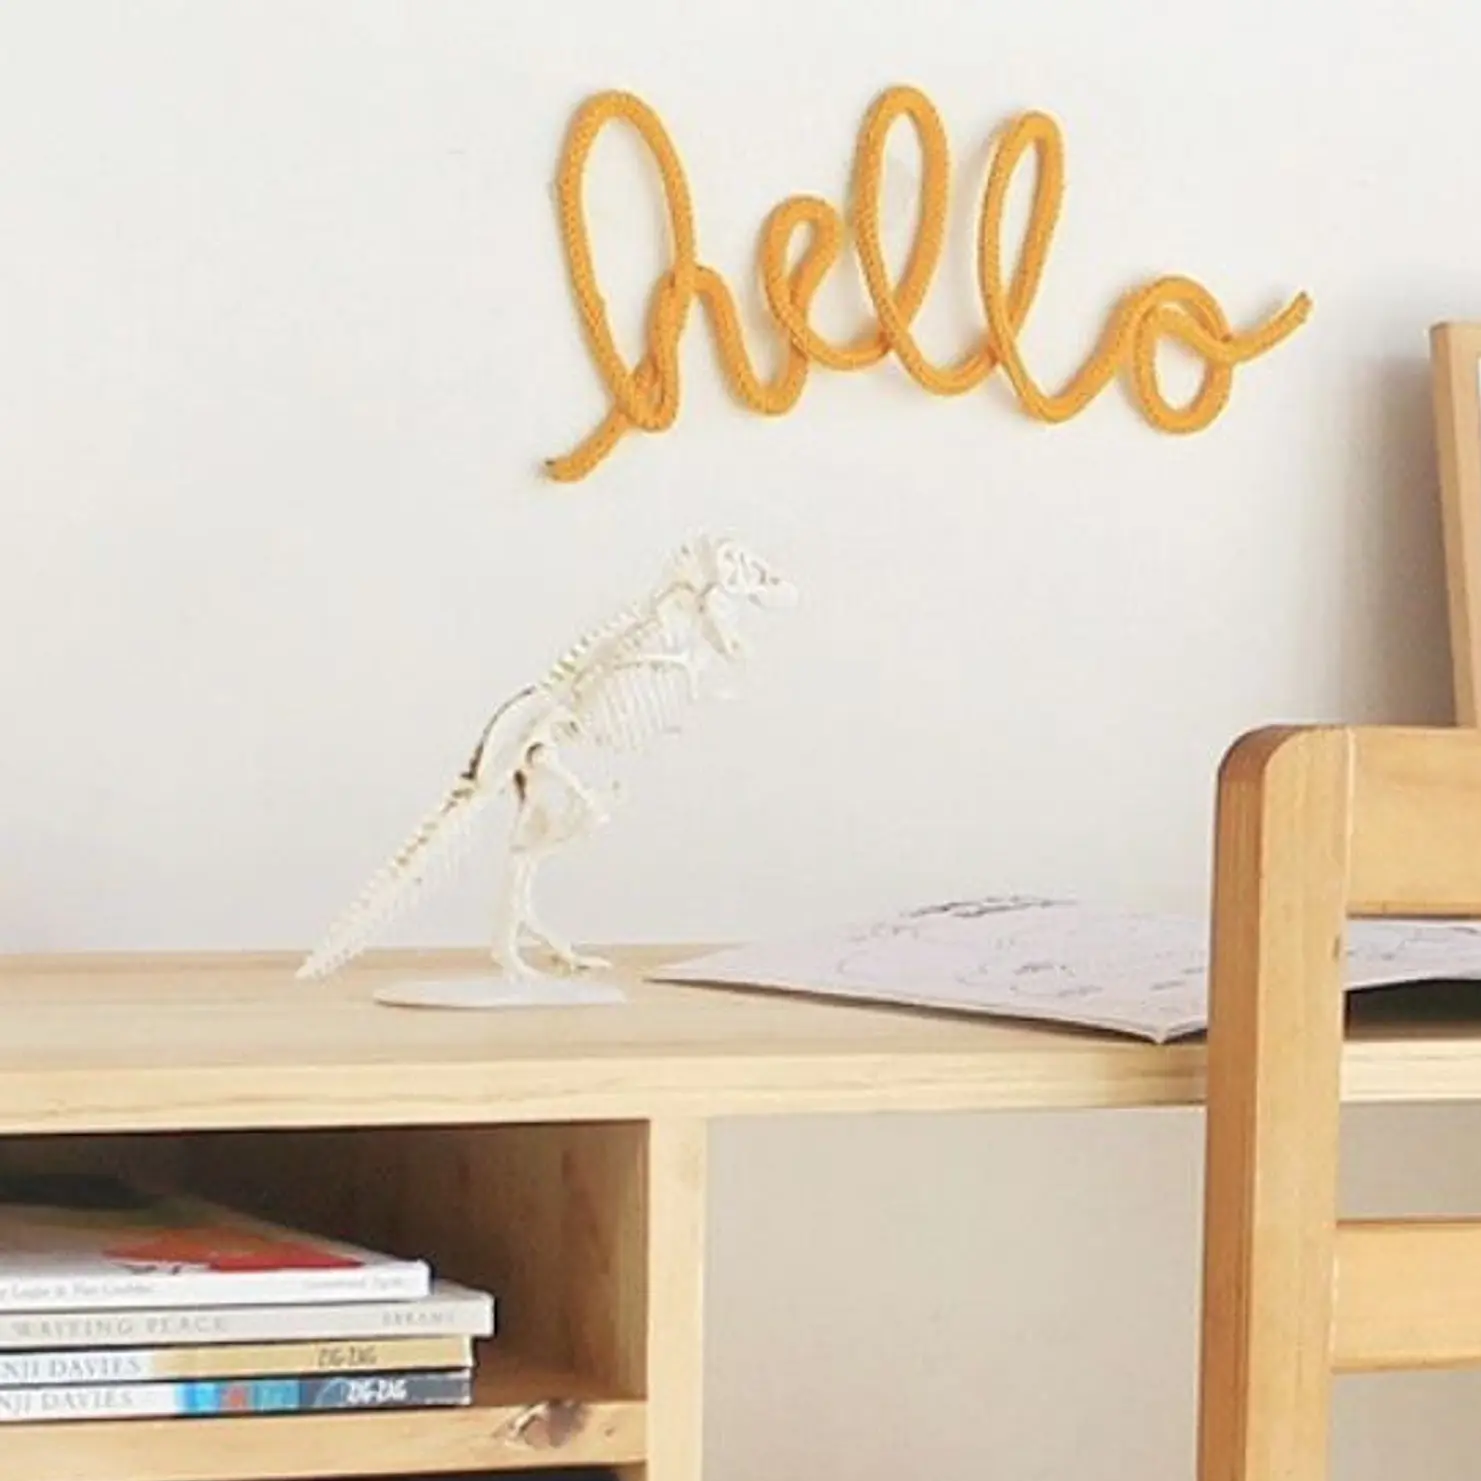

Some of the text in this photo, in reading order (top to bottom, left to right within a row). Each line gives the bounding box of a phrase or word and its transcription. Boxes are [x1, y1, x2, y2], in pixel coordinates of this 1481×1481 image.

[543, 85, 1313, 483] hello
[48, 1356, 141, 1378] DAVIES
[41, 1390, 133, 1410] DAVIES
